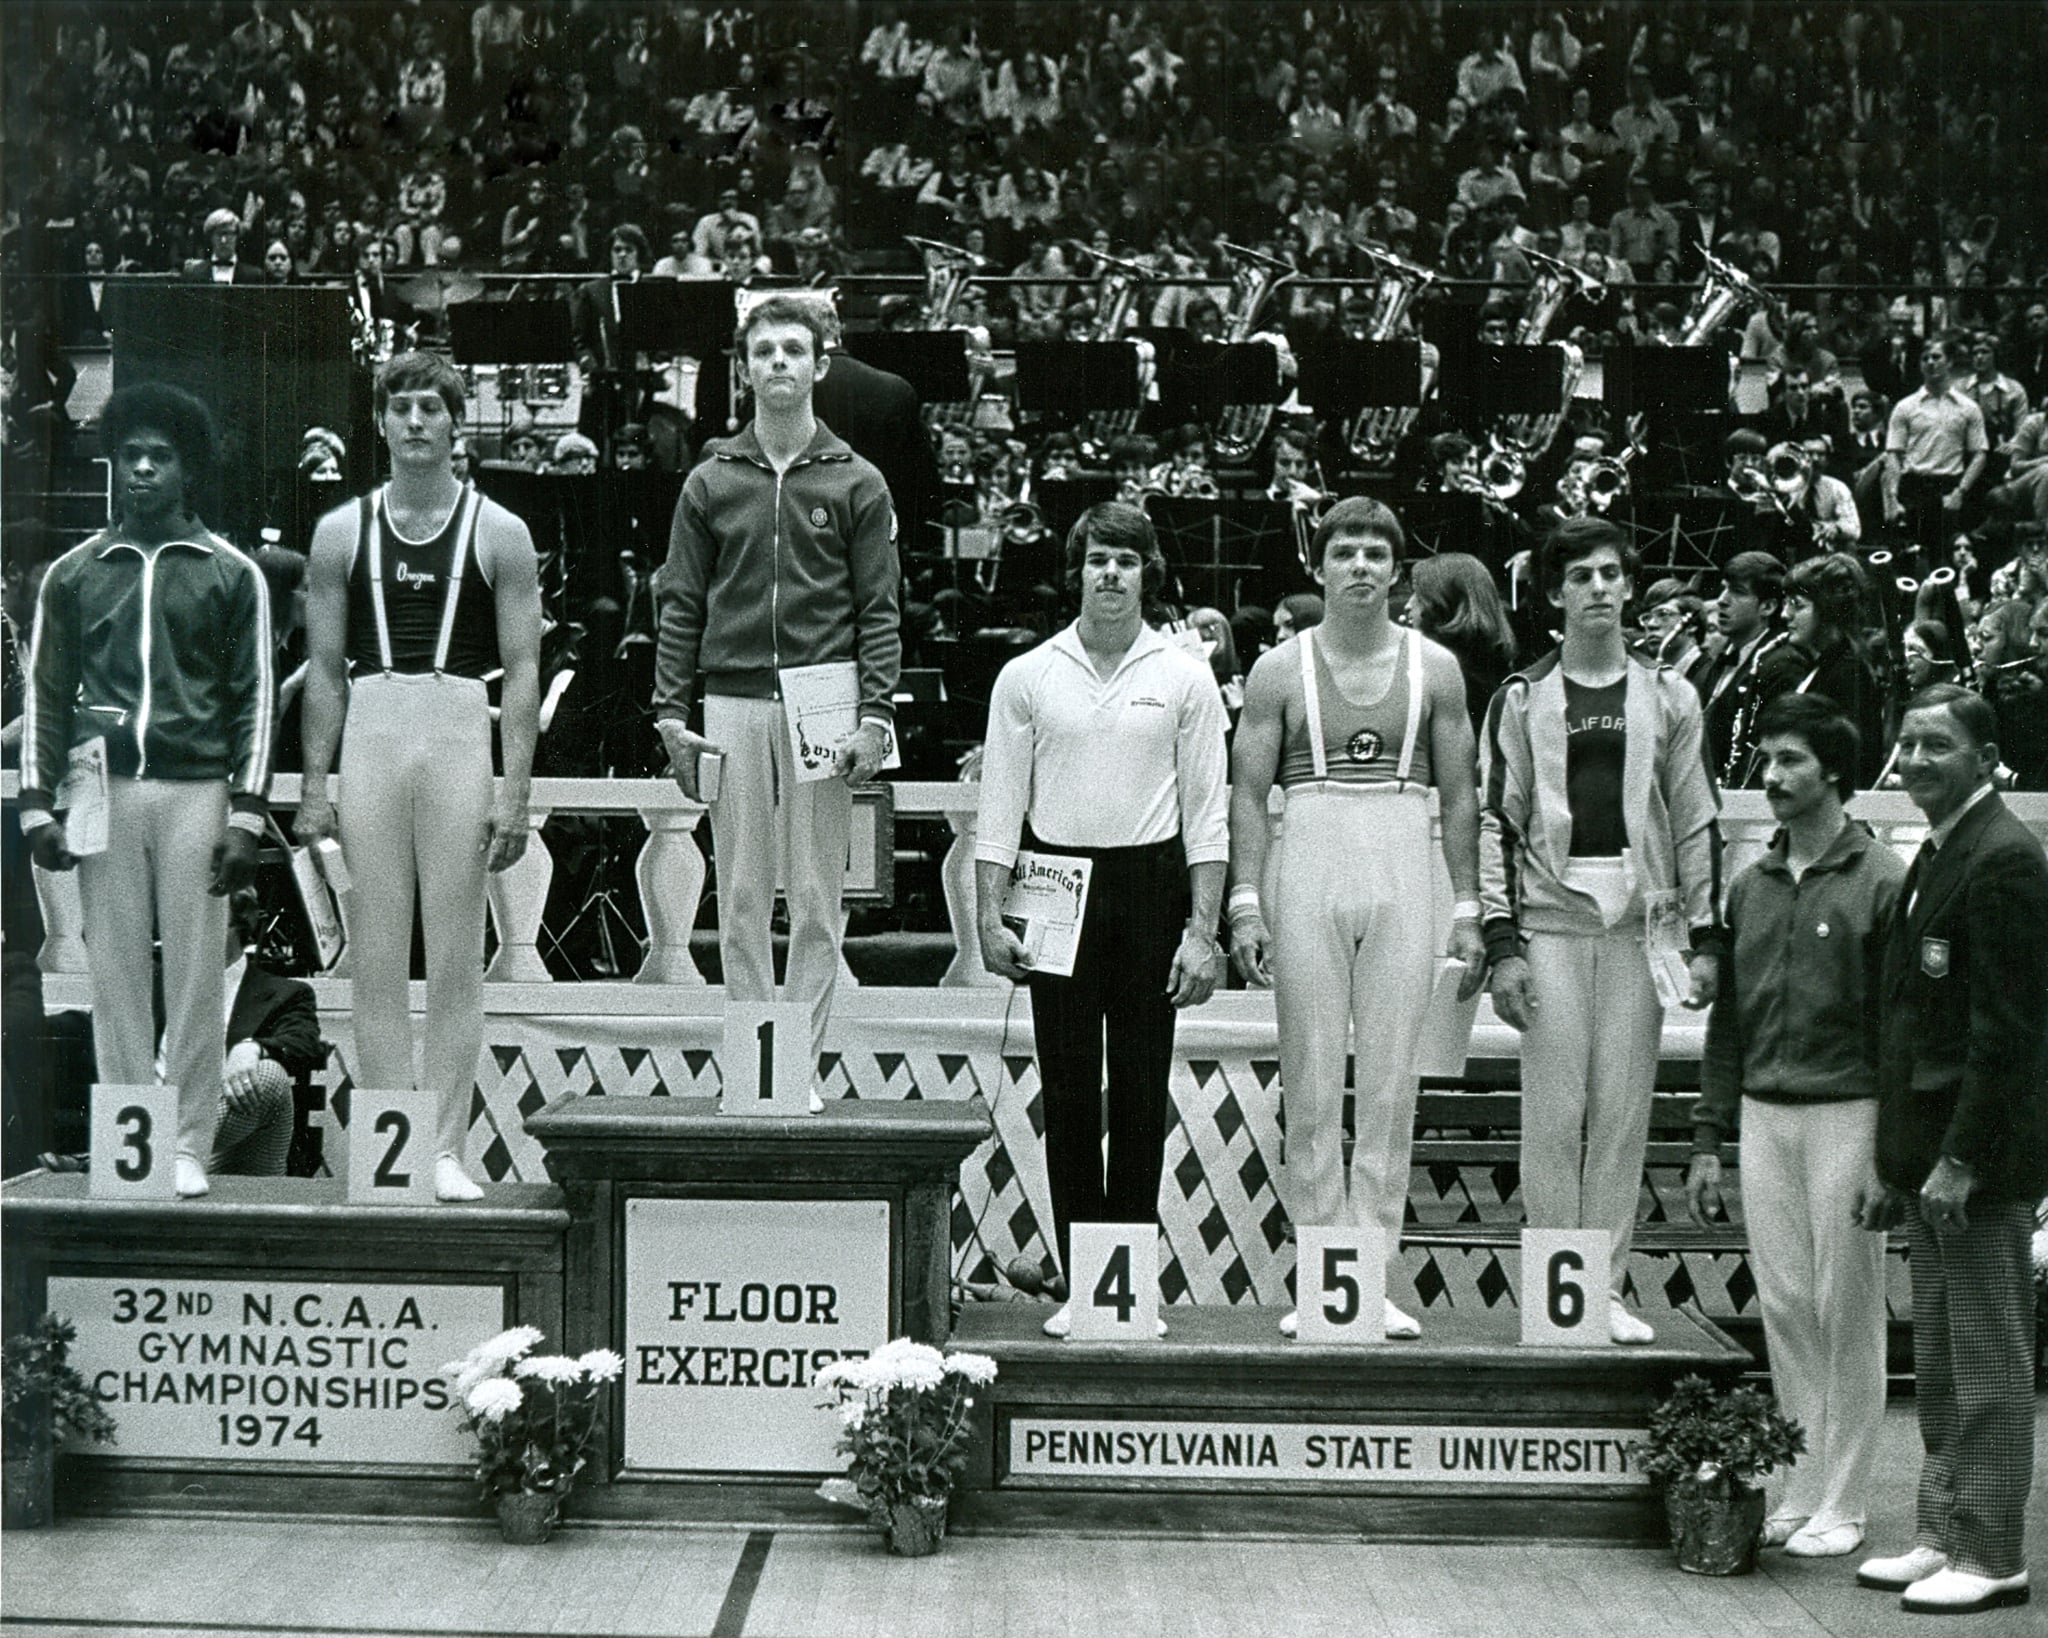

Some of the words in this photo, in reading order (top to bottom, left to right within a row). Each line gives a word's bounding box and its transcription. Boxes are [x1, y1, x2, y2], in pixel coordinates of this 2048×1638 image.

[1566, 715, 1625, 735] LIFOR
[1028, 860, 1074, 891] America
[757, 1020, 775, 1100] 1
[114, 1105, 153, 1182] 3
[373, 1110, 412, 1188] 2
[668, 1281, 839, 1324] FLOOR
[1093, 1244, 1136, 1323] 4
[1323, 1247, 1360, 1325] 5
[1546, 1249, 1584, 1328] 6
[243, 1293, 438, 1330] N.C.A.A.
[138, 1331, 408, 1370] GYMNASTIC
[93, 1370, 449, 1411] CHAMPIONSHIPS
[219, 1414, 322, 1448] 1974
[1026, 1429, 1278, 1468] PENNSYLVANIA
[1305, 1434, 1412, 1470] STATE
[1440, 1438, 1634, 1474] UNIVERSITY
